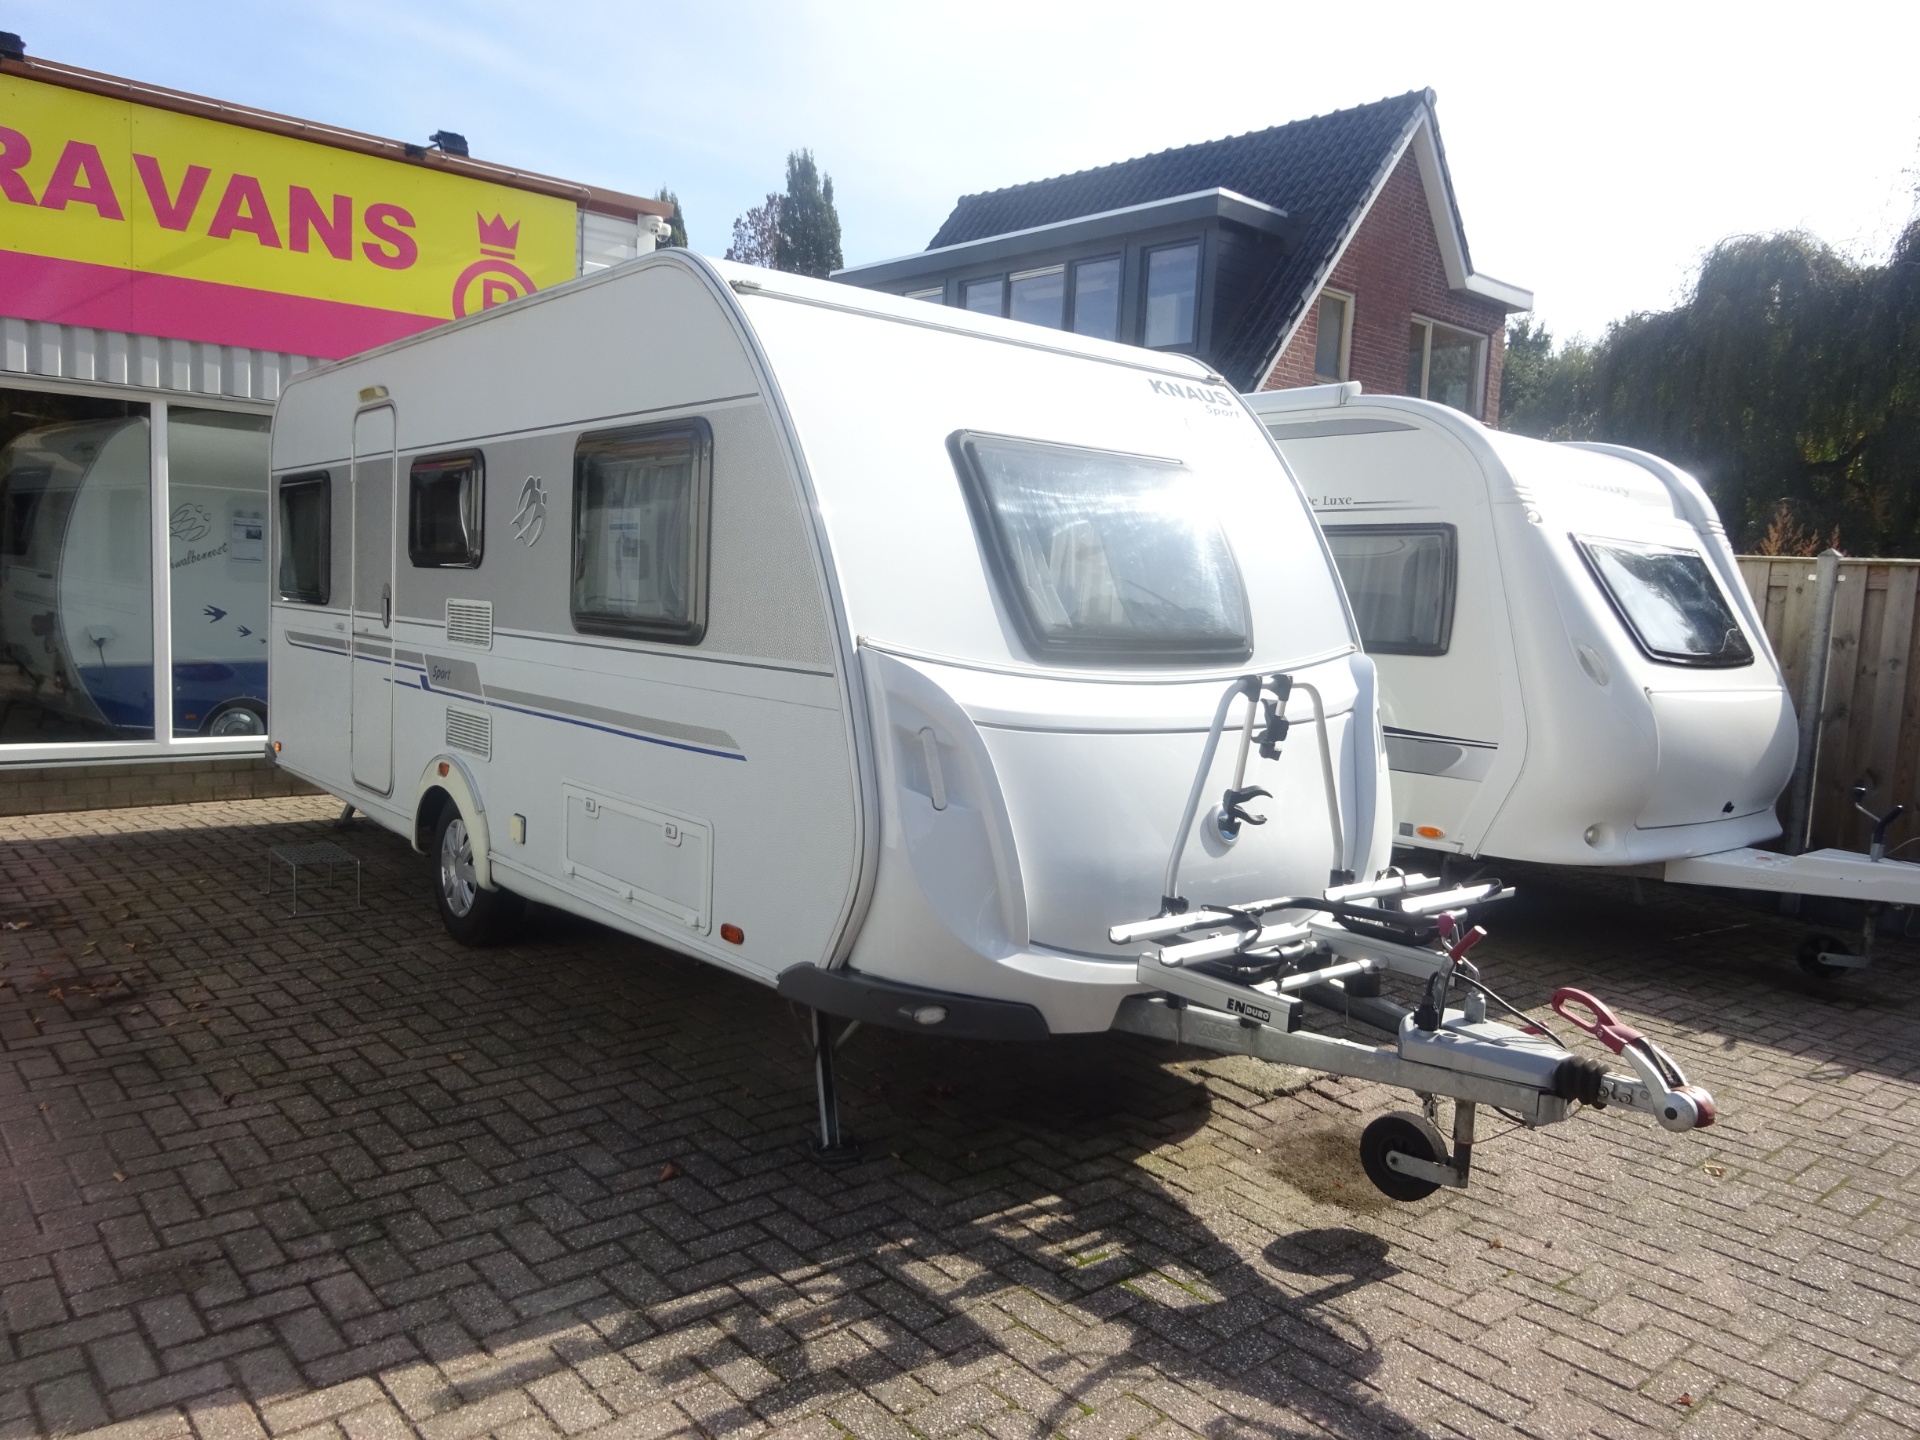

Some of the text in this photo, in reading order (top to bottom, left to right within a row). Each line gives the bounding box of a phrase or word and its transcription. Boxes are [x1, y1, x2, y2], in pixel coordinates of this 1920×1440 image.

[1147, 378, 1232, 407] KNAUS
[1205, 404, 1240, 419] Sport
[1323, 495, 1352, 506] Luxe
[432, 665, 451, 681] Sport
